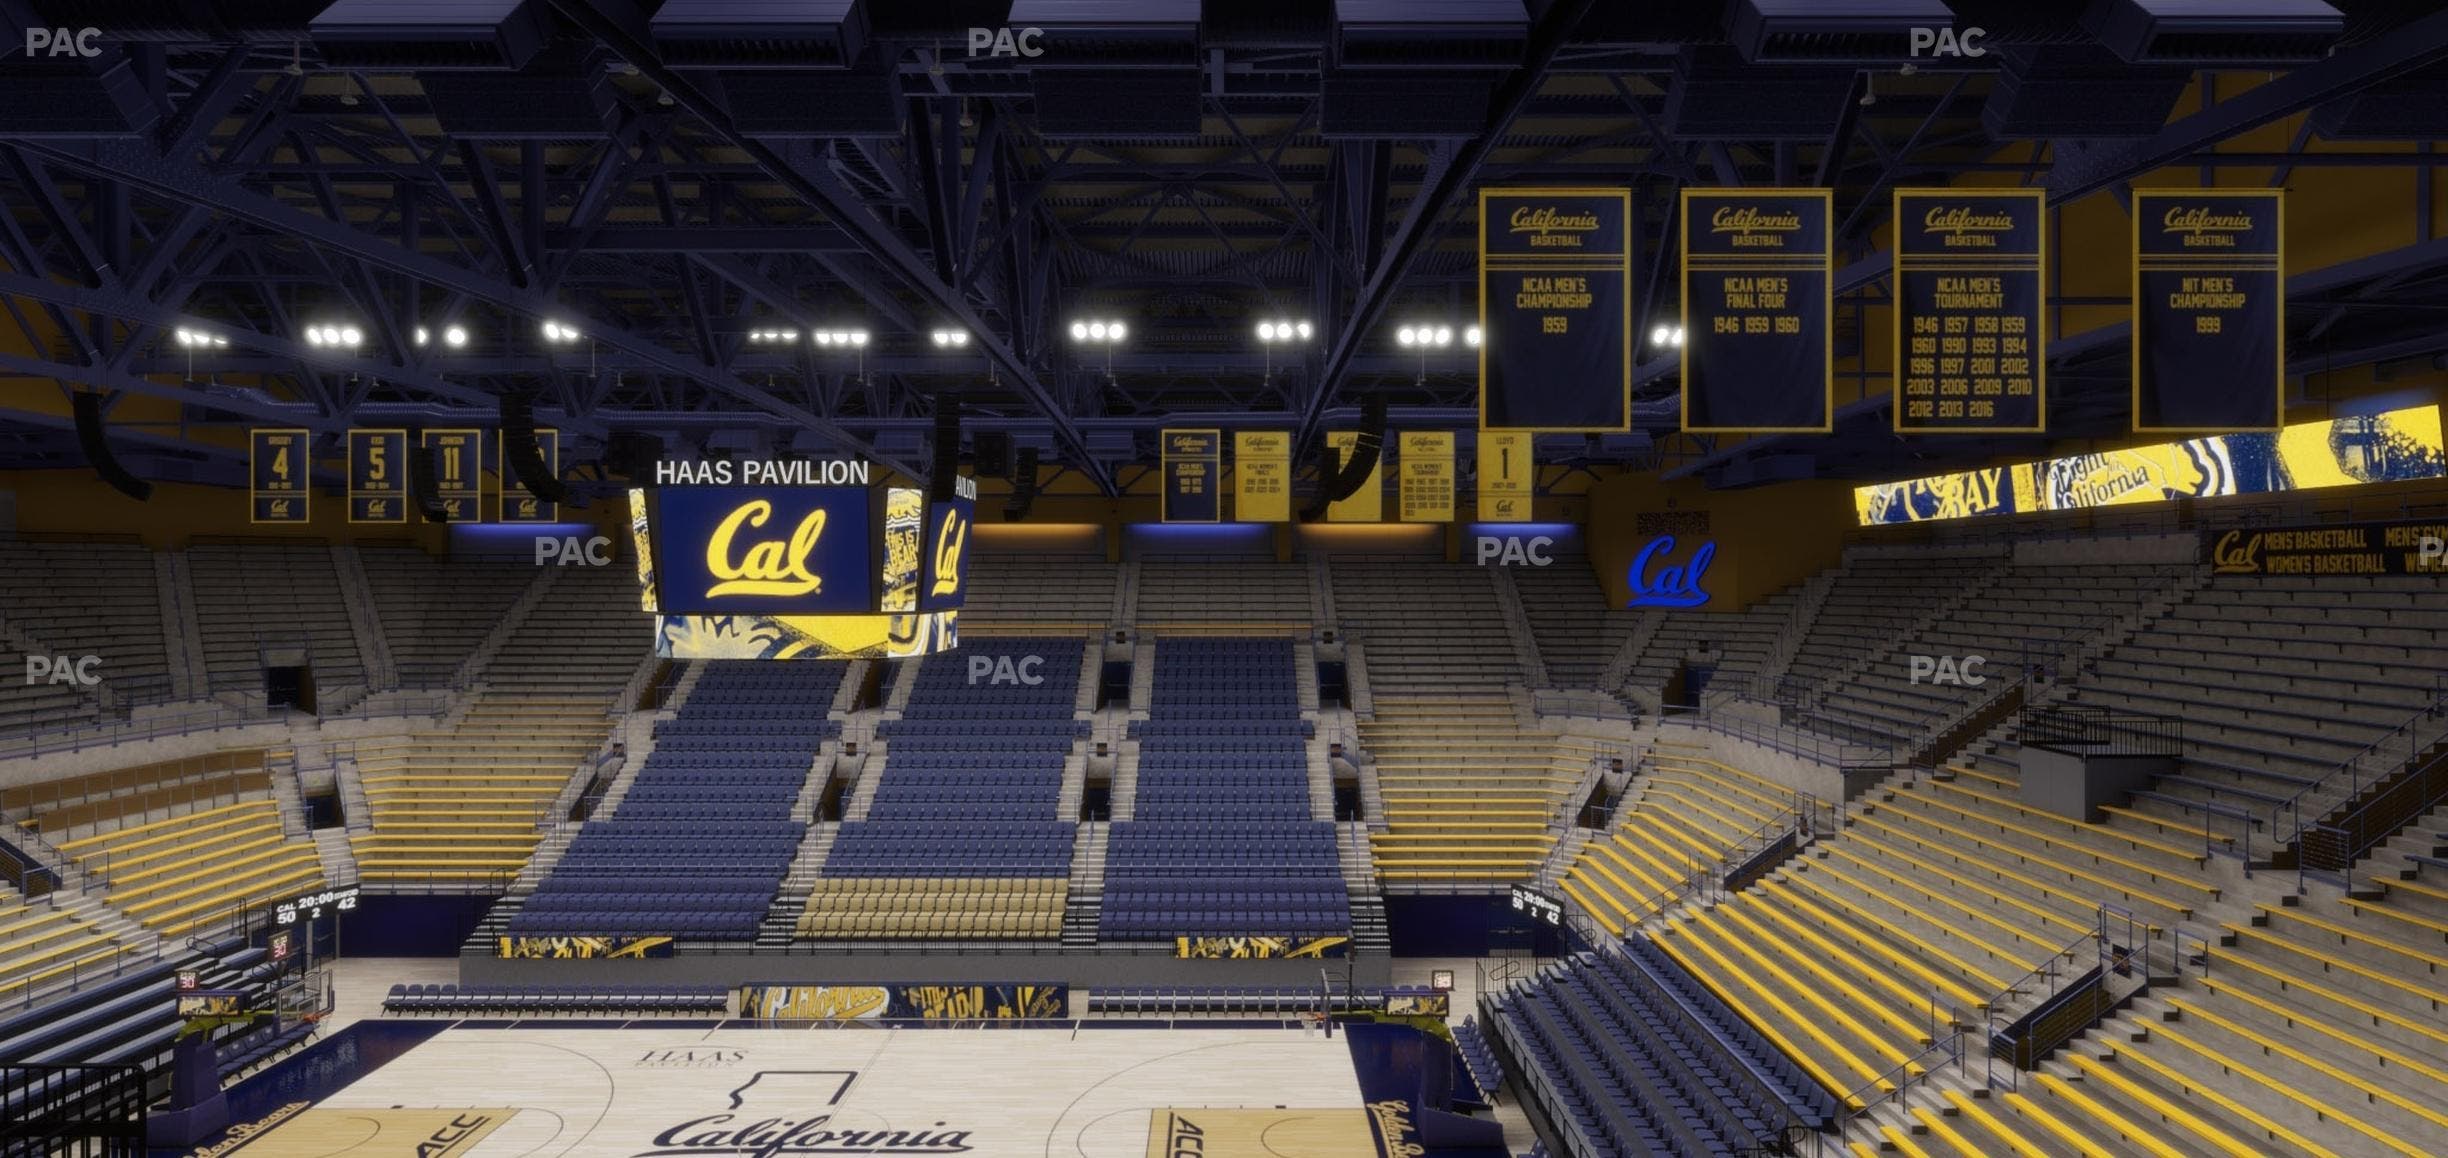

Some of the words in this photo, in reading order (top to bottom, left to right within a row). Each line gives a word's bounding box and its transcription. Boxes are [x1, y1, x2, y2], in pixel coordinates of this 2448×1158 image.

[1510, 206, 1600, 234] California
[1712, 206, 1802, 234] California
[1924, 206, 2014, 235] California
[2162, 206, 2253, 234] California
[1530, 235, 1583, 246] BASKETBALL
[1732, 235, 1784, 246] BASKETBALL
[1944, 235, 1997, 246] BASKETBALL
[2184, 235, 2236, 246] BASKETBALL
[1522, 277, 1553, 292] NCAA
[1555, 277, 1587, 292] MEN'S
[1724, 277, 1754, 292] NCAA
[1756, 277, 1789, 292] MEN'S
[1937, 277, 1967, 292] NCAA
[1969, 277, 2001, 292] MEN'S
[2182, 277, 2200, 292] NIT
[2202, 277, 2234, 292] MEN'S
[1516, 293, 1593, 309] CHAMPIONSHIP
[1726, 293, 1757, 309] FINAL
[1758, 293, 1786, 309] FOUR
[1935, 293, 2004, 309] TOURNAMENT
[2170, 293, 2246, 309] CHAMPIONSHIP
[1542, 316, 1568, 333] 1959
[1714, 316, 1740, 333] 1946
[1744, 316, 1770, 333] 1959
[1775, 316, 1800, 333] 1960
[1913, 316, 1939, 334] 1946
[1944, 316, 1969, 334] 1957
[2001, 316, 2026, 334] 1959
[2196, 316, 2222, 333] 1999
[1911, 336, 1936, 354] 1960
[1942, 336, 1967, 354] 1990
[1972, 336, 1997, 354] 1993
[2002, 336, 2028, 354] 1994
[1940, 357, 1965, 374] 1997
[1970, 357, 1996, 374] 2001
[2001, 357, 2029, 374] 2002
[1906, 378, 1935, 395] 2003
[1940, 378, 1968, 395] 2006
[1973, 378, 2002, 395] 2009
[2008, 378, 2033, 395] 2010
[1908, 399, 1934, 417] 2012
[1938, 399, 1963, 417] 2013
[1968, 399, 1994, 417] 2016
[272, 447, 288, 480] 4
[369, 447, 385, 480] 5
[444, 447, 459, 480] 11
[1502, 448, 1508, 479] 1
[656, 460, 733, 484] HAAS
[743, 460, 869, 485] PAVILION
[1496, 500, 1513, 513] Cal
[2296, 529, 2367, 549] BASKETBALL
[706, 500, 826, 597] Cal
[932, 508, 967, 597] Cal
[2214, 530, 2263, 574] Cal
[1627, 534, 1716, 608] Cal
[2313, 553, 2386, 574] BASKETBALL
[277, 903, 296, 913] CAL
[299, 892, 334, 909] 20:00
[337, 897, 356, 910] 42
[1512, 897, 1524, 910] 50
[1524, 891, 1545, 907] 20:00
[278, 911, 296, 924] 50
[312, 907, 320, 918] 2
[1531, 907, 1537, 917] 2
[1546, 911, 1559, 925] 42
[274, 944, 286, 958] 30
[182, 977, 195, 988] 30
[640, 1050, 748, 1062] HAAS
[417, 1113, 485, 1158] ACC
[650, 1114, 976, 1158] California
